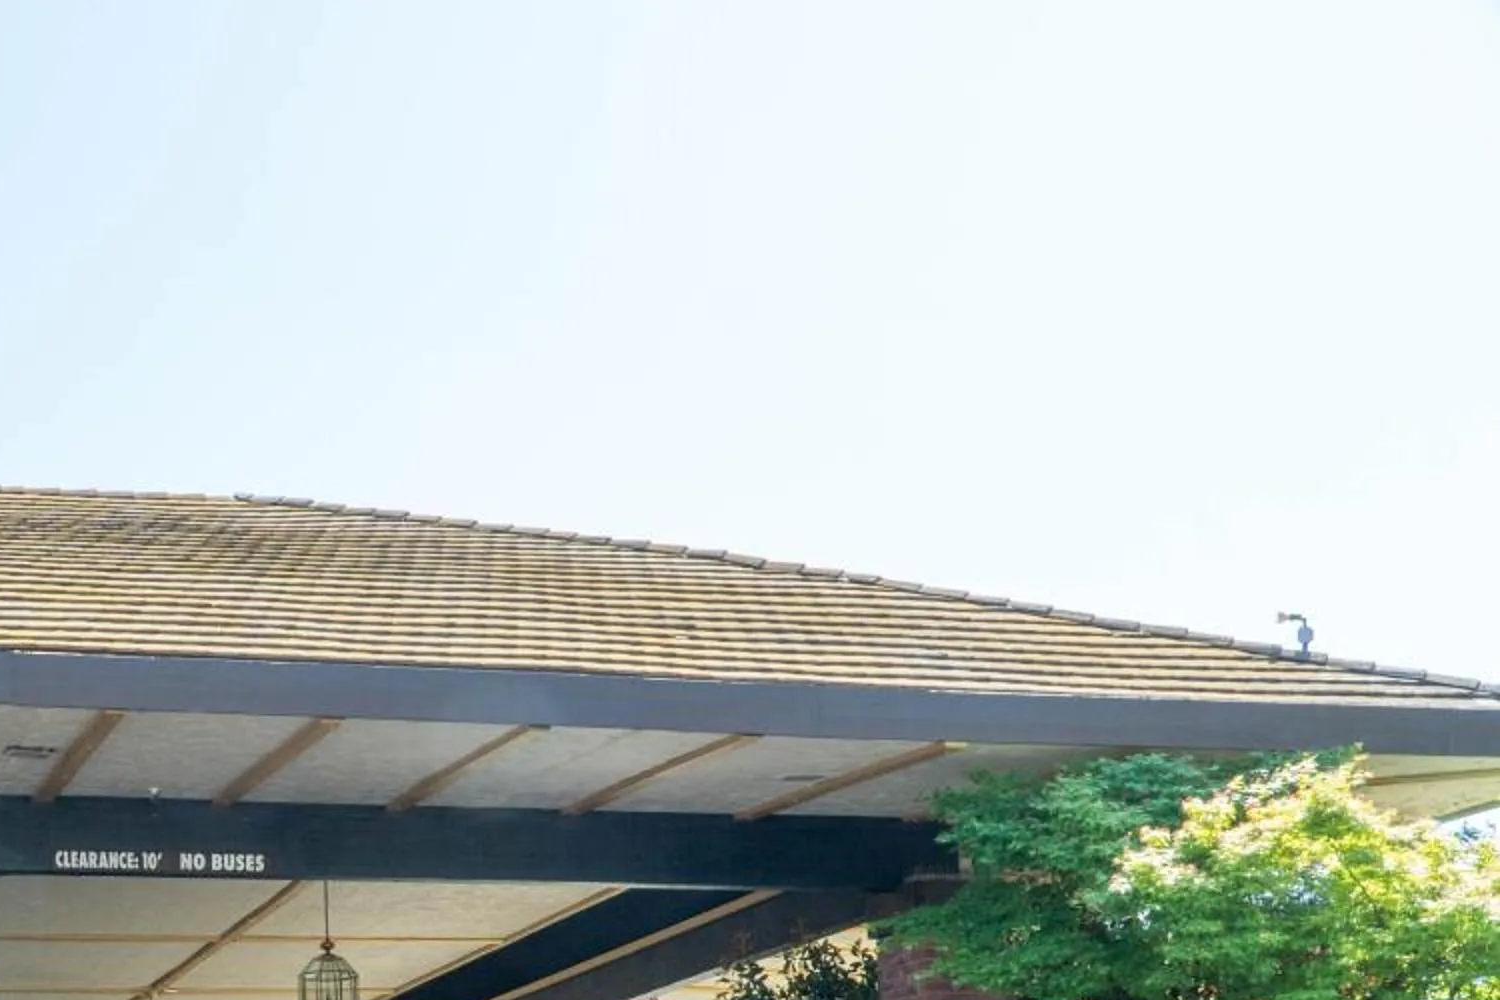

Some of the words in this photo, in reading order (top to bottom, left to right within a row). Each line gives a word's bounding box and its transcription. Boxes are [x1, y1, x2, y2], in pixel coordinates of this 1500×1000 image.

[54, 850, 139, 869] CLEARANCE:
[179, 853, 206, 871] NO
[211, 853, 265, 872] BUSES
